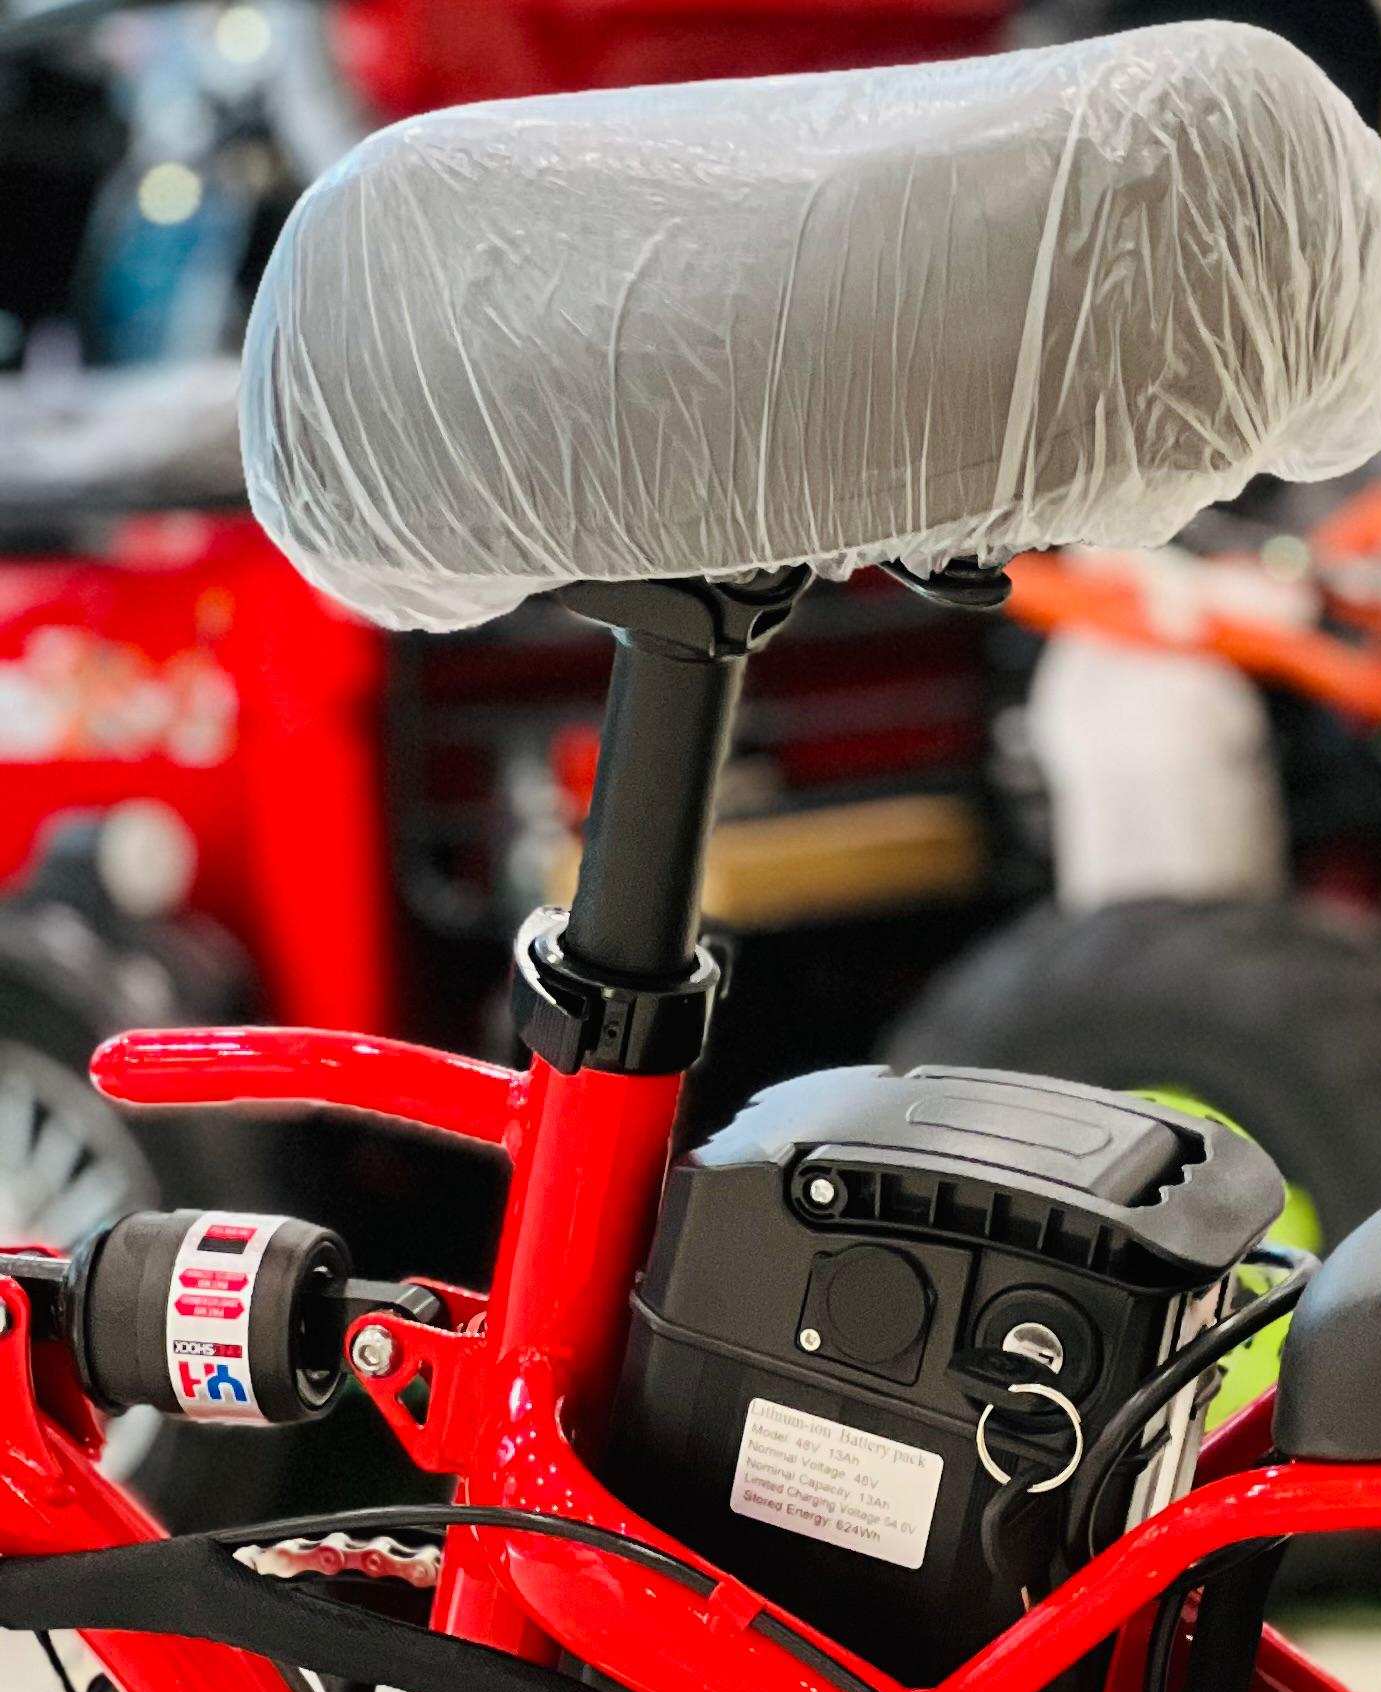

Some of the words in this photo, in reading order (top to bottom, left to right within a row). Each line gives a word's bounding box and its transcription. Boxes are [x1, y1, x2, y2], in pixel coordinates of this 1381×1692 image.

[748, 1439, 796, 1464] Nominal
[854, 1473, 880, 1489] 48V
[796, 1438, 822, 1454] 48V
[830, 1448, 860, 1467] 13Ah
[840, 1428, 889, 1457] Battery
[894, 1450, 926, 1469] pack
[744, 1472, 784, 1494] Limited
[787, 1486, 836, 1513] Charging
[746, 1455, 796, 1481] Nominal
[860, 1492, 891, 1511] 13Ah
[743, 1489, 783, 1512] Stored
[836, 1519, 881, 1543] 624Wh
